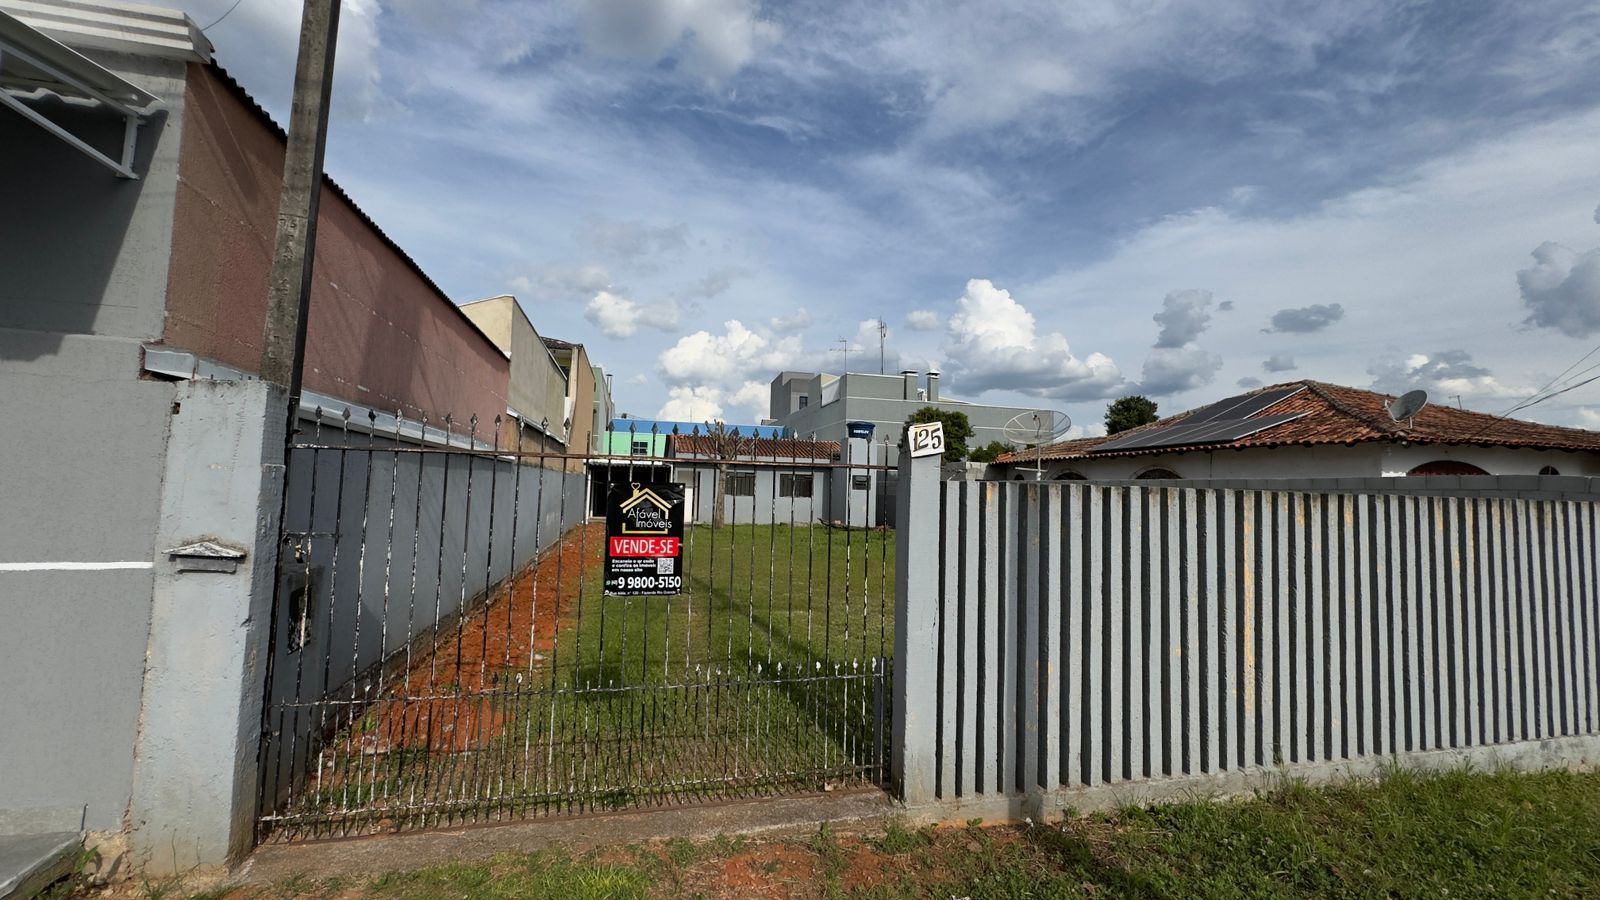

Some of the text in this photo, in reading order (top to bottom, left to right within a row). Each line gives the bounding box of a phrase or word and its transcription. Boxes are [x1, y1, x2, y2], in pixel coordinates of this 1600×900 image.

[913, 428, 942, 452] 125
[627, 507, 661, 519] Afável
[636, 519, 672, 529] Imóveis
[614, 539, 673, 554] VENDE-SE
[618, 576, 625, 588] 9
[628, 576, 681, 588] 9800-5150
